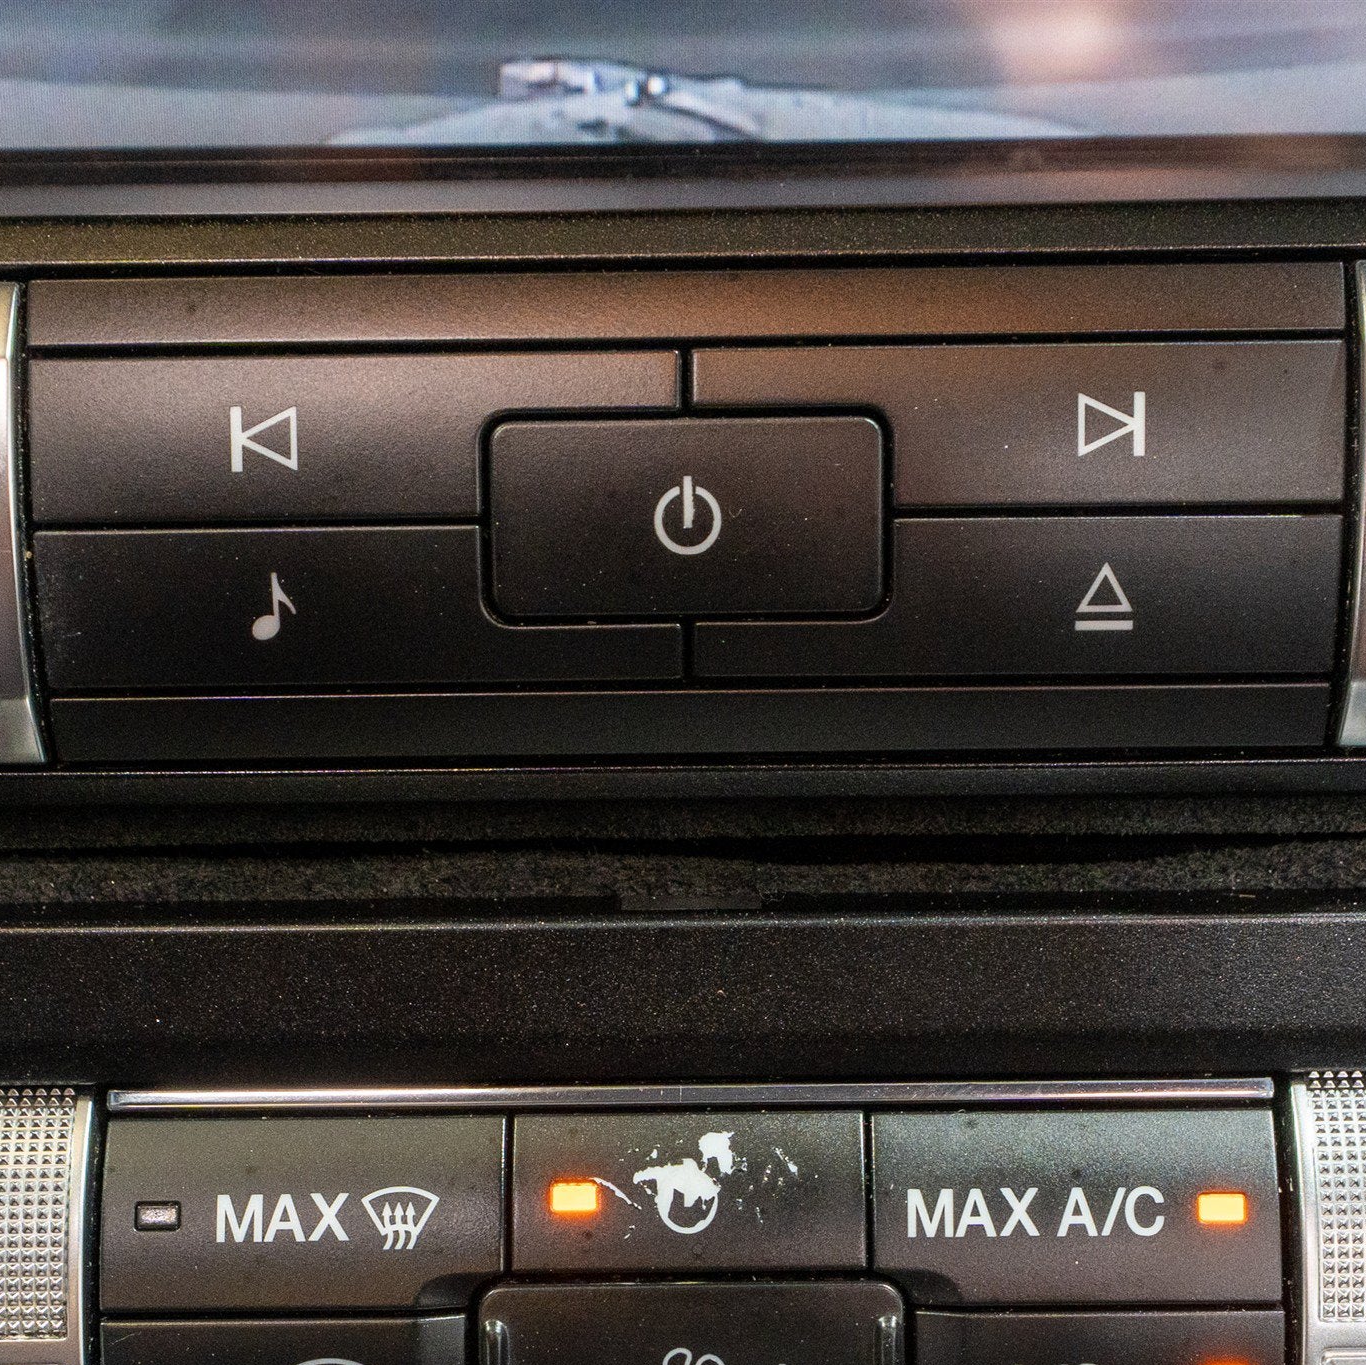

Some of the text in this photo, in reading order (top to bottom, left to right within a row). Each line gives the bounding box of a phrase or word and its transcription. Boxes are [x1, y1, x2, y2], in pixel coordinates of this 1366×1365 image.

[214, 1192, 351, 1243] MAX
[906, 1185, 1165, 1238] MAX A/C
